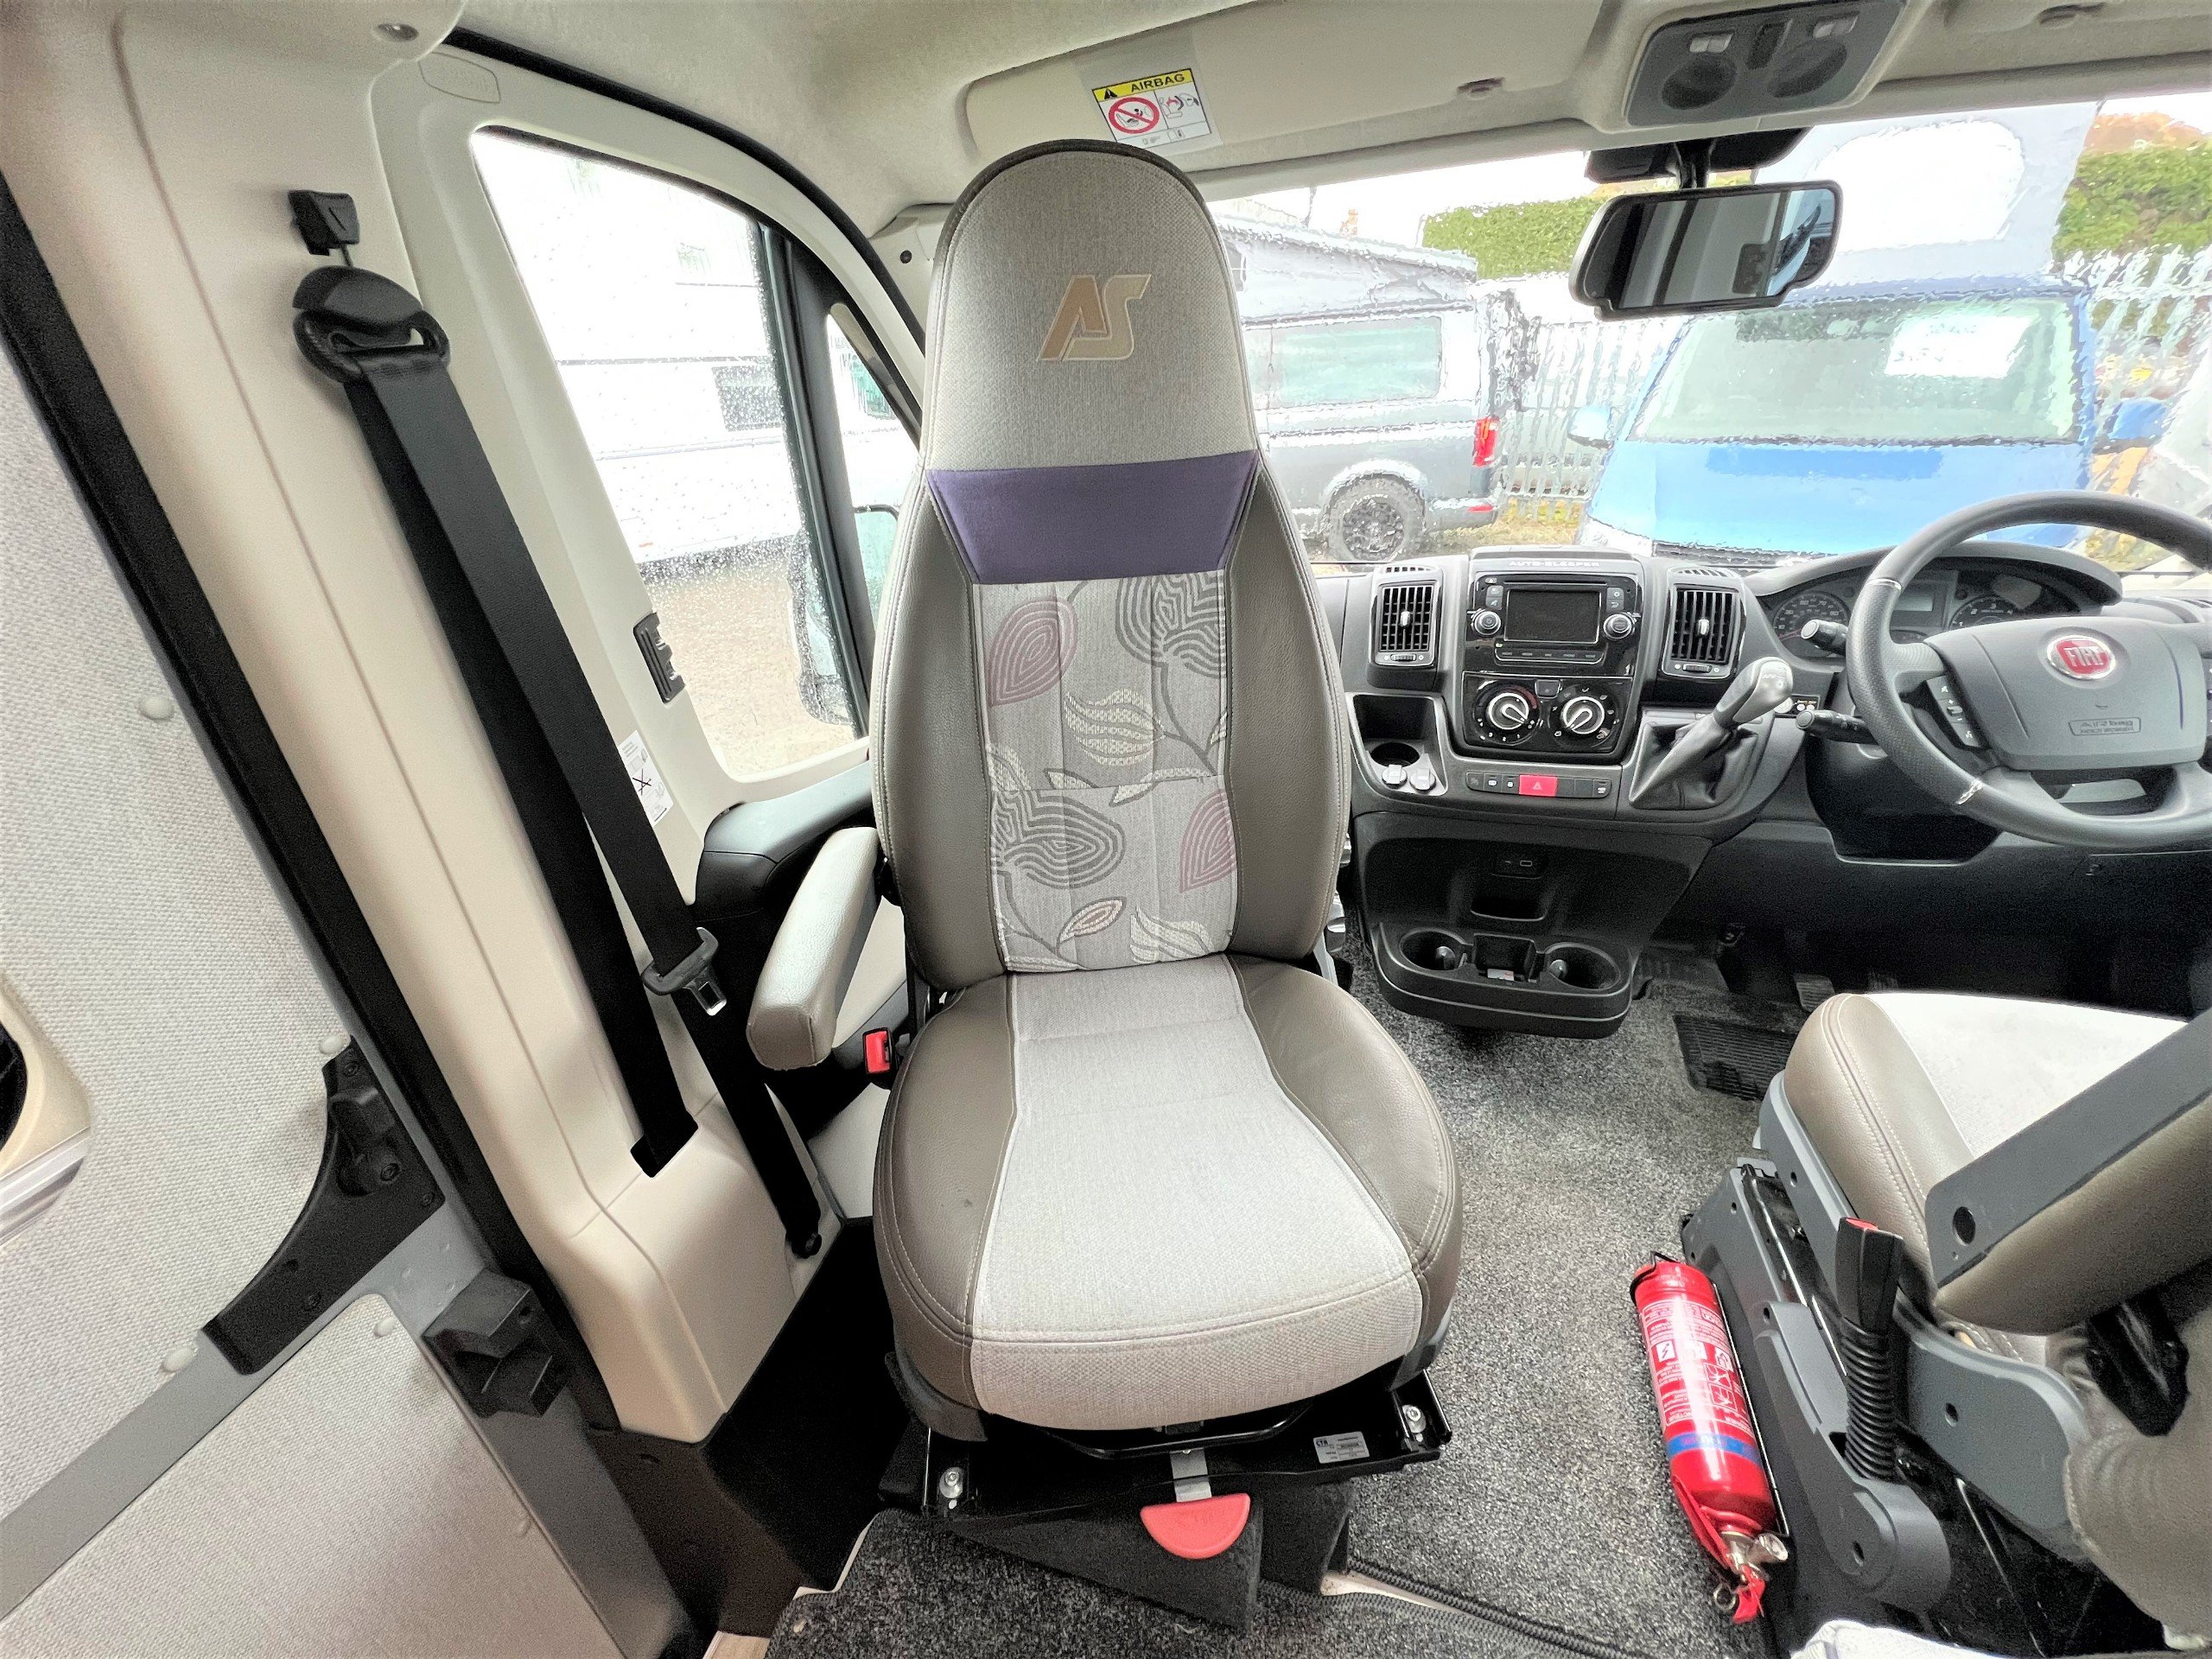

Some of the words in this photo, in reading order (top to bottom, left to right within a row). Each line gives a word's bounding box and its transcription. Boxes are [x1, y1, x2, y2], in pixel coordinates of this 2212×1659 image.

[1130, 73, 1185, 92] AIRBAG
[1036, 273, 1153, 362] AS
[2063, 646, 2105, 667] FIAT
